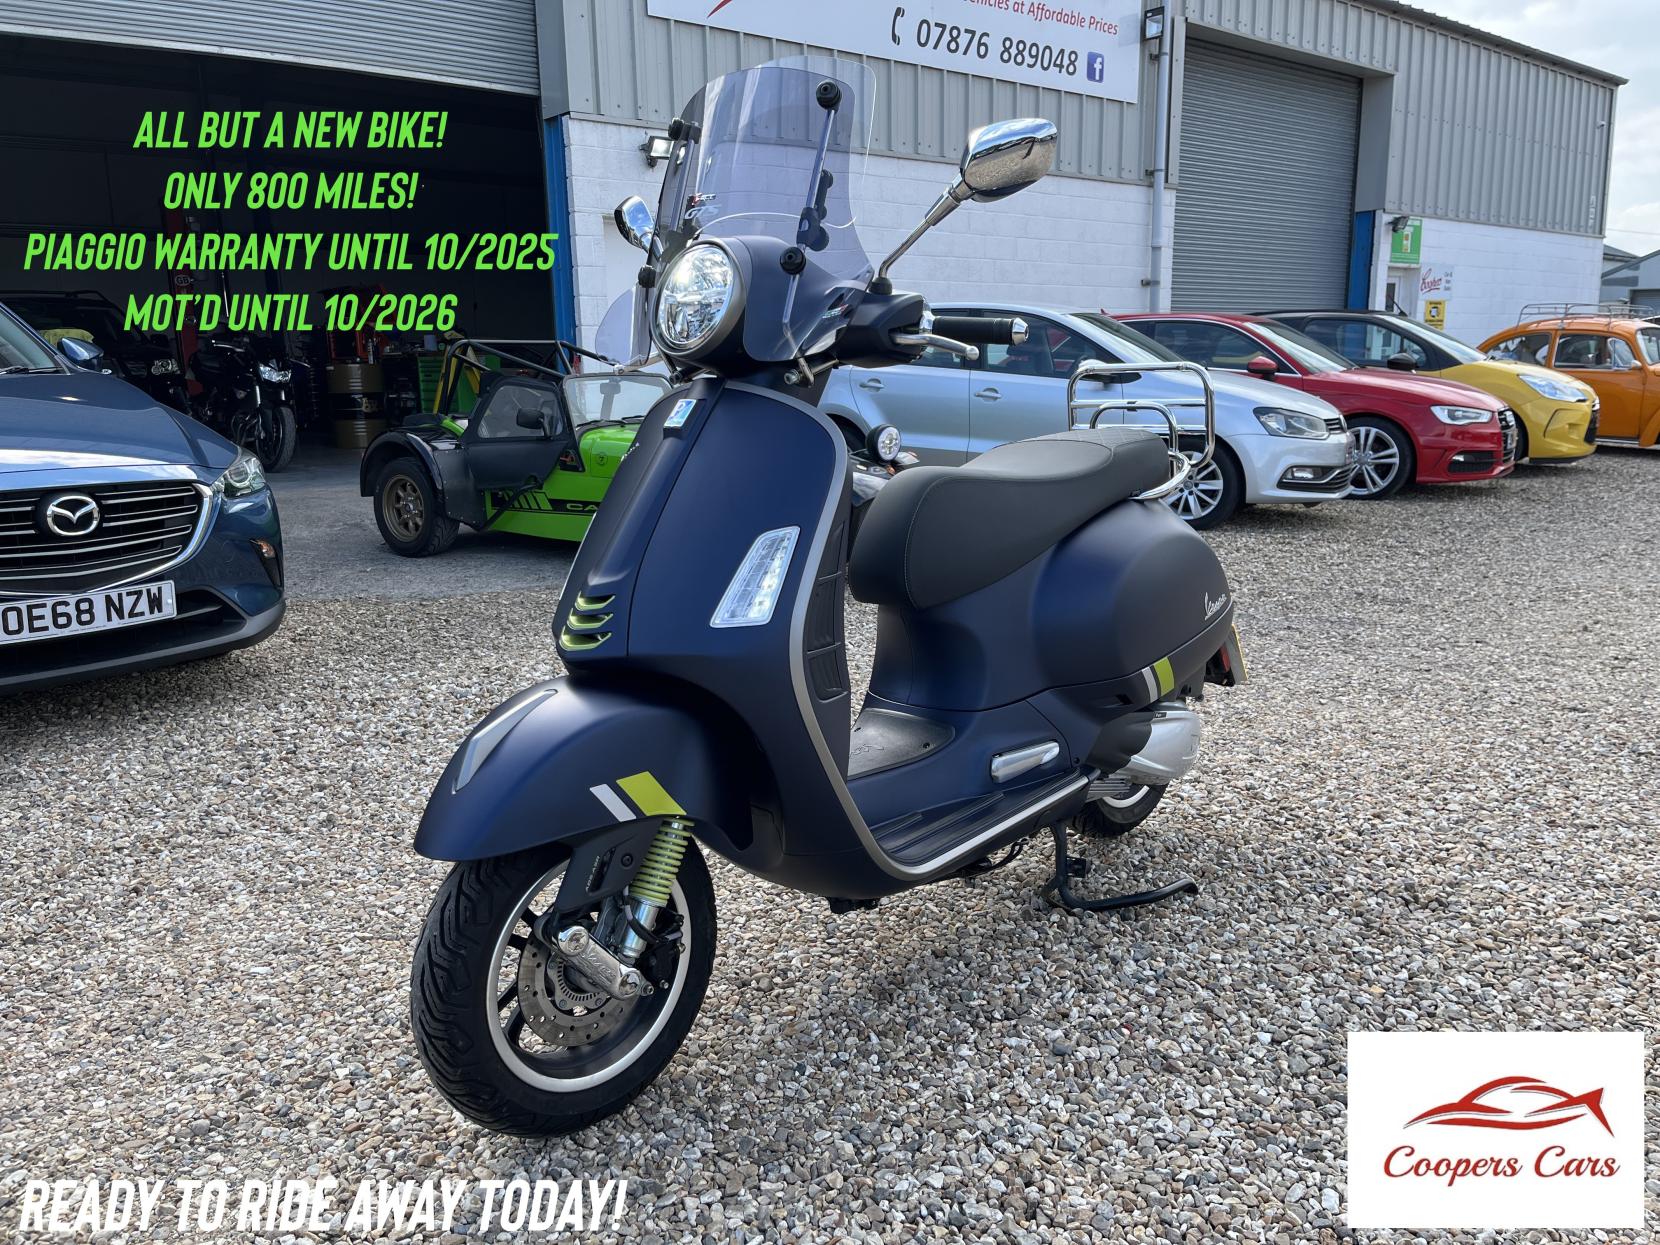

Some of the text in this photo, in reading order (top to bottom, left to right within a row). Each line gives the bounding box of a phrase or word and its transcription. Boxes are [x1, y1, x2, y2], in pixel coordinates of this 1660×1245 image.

[963, 0, 1119, 35] cles at Affordable Prices
[916, 18, 1079, 76] 07876 889048
[1, 586, 164, 636] OE68 NZW
